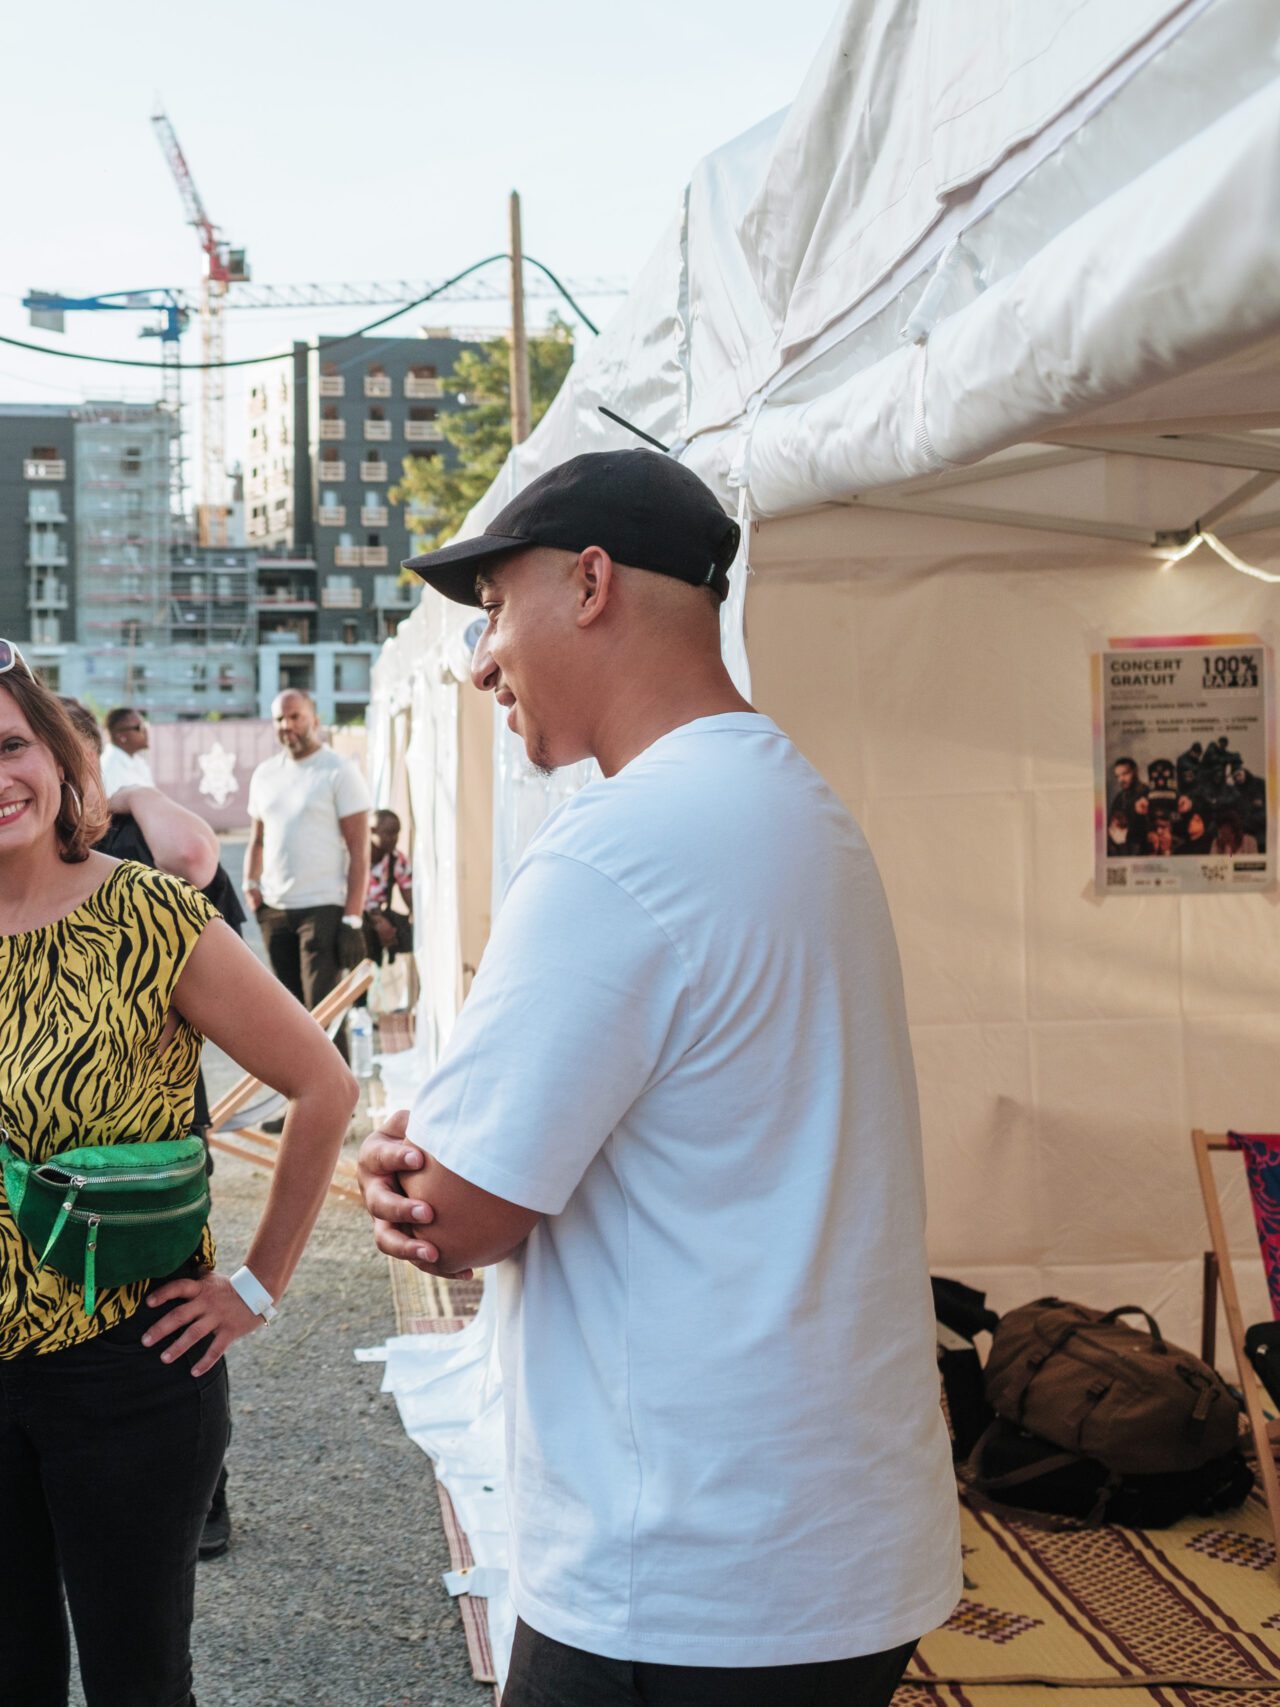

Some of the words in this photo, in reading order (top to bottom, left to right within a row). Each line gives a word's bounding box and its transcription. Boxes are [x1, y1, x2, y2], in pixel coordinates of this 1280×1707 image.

[1110, 658, 1182, 672] CONCERT
[1203, 655, 1258, 675] 100%
[1110, 674, 1176, 686] GRATUIT
